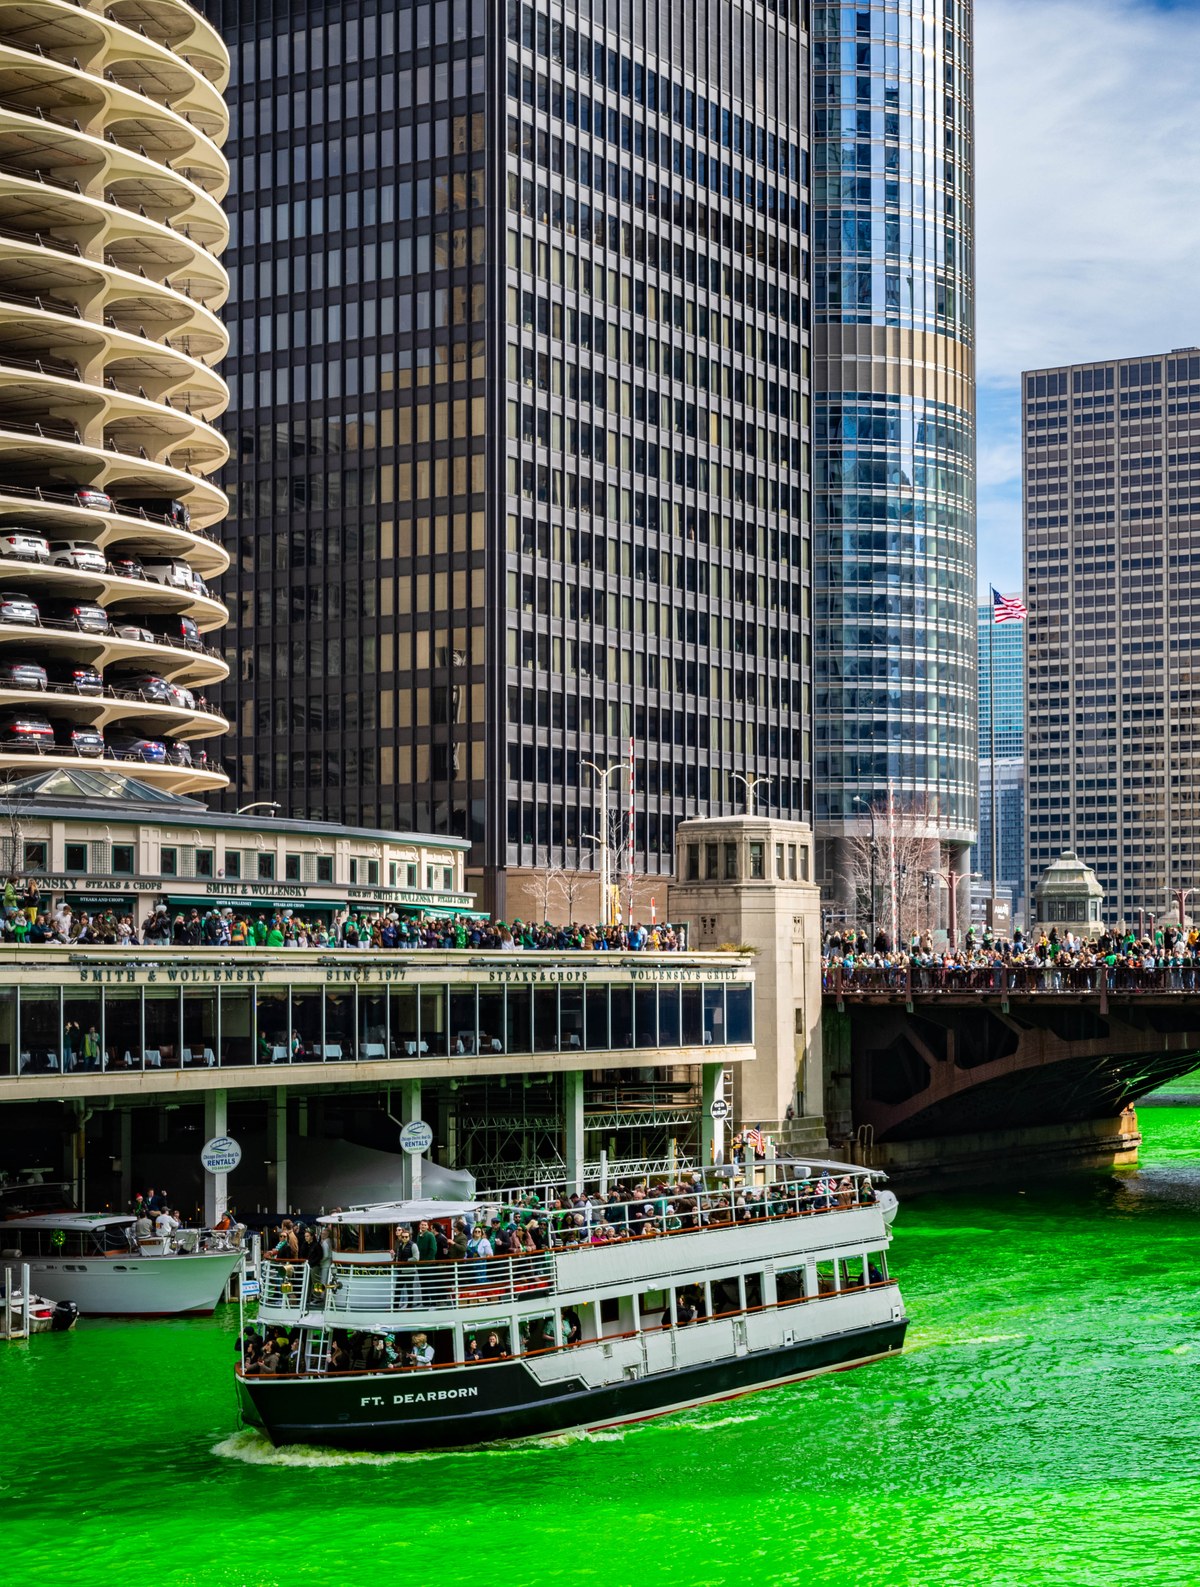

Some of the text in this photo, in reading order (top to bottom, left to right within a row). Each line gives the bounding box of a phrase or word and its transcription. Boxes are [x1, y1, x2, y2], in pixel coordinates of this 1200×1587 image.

[0, 877, 162, 890] WLLENSKY STEAKS & CHOPS
[206, 883, 308, 897] SMITH & WOLLENSKY
[374, 889, 393, 901] SMITH
[401, 892, 435, 904] WOLLENSKY
[80, 969, 265, 982] SMITH & WOLLENSKY
[326, 970, 406, 982] SINCE 1977
[630, 970, 737, 980] WOLLENSKY'S GRILL
[405, 1140, 428, 1148] RENTALS
[207, 1158, 236, 1166] RENTALS
[361, 1387, 478, 1406] FT. DEARBORN
